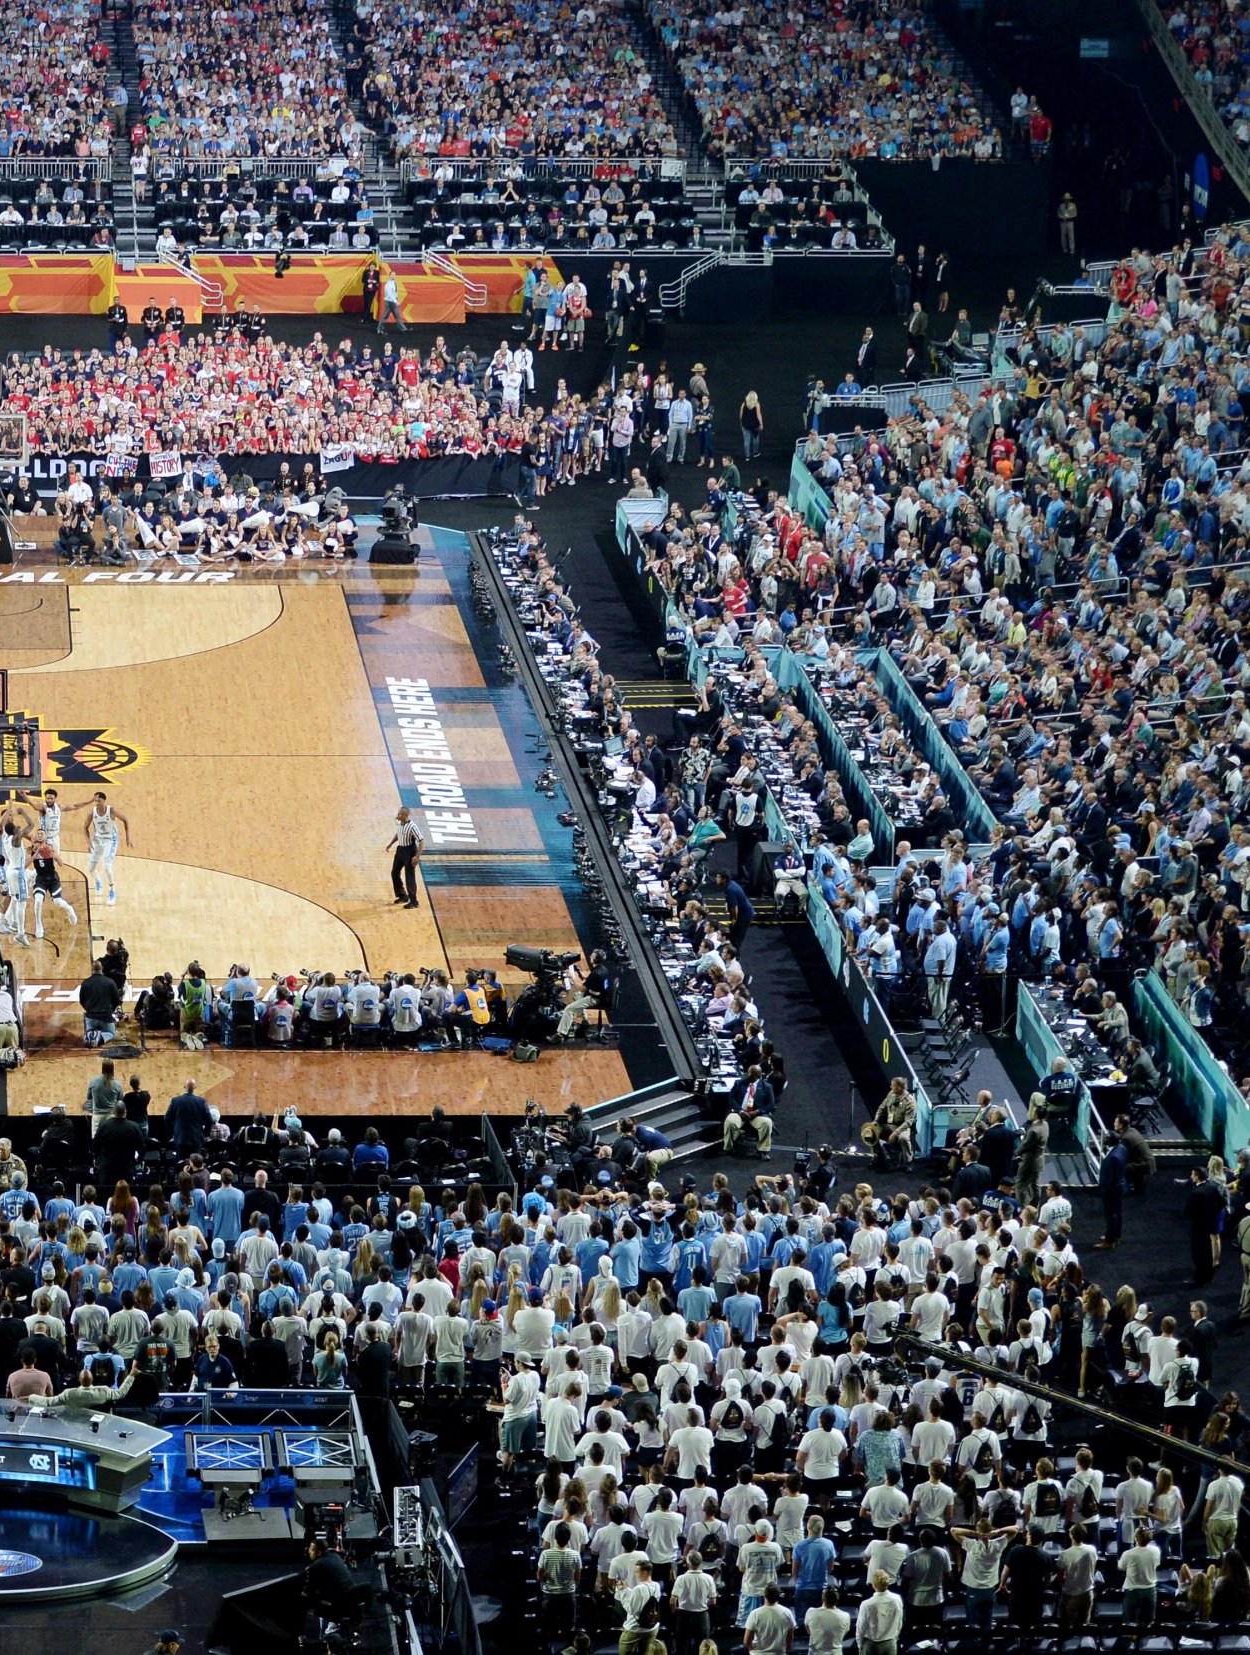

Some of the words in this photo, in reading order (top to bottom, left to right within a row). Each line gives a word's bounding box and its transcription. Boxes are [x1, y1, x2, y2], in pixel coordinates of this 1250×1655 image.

[151, 458, 178, 475] HISTORY
[82, 571, 237, 583] FOUR
[385, 676, 438, 716] HERE
[397, 717, 452, 760] ENDS
[410, 762, 468, 808] ROAD
[424, 810, 479, 843] THE
[38, 859, 45, 868] 5
[377, 1202, 387, 1217] 5
